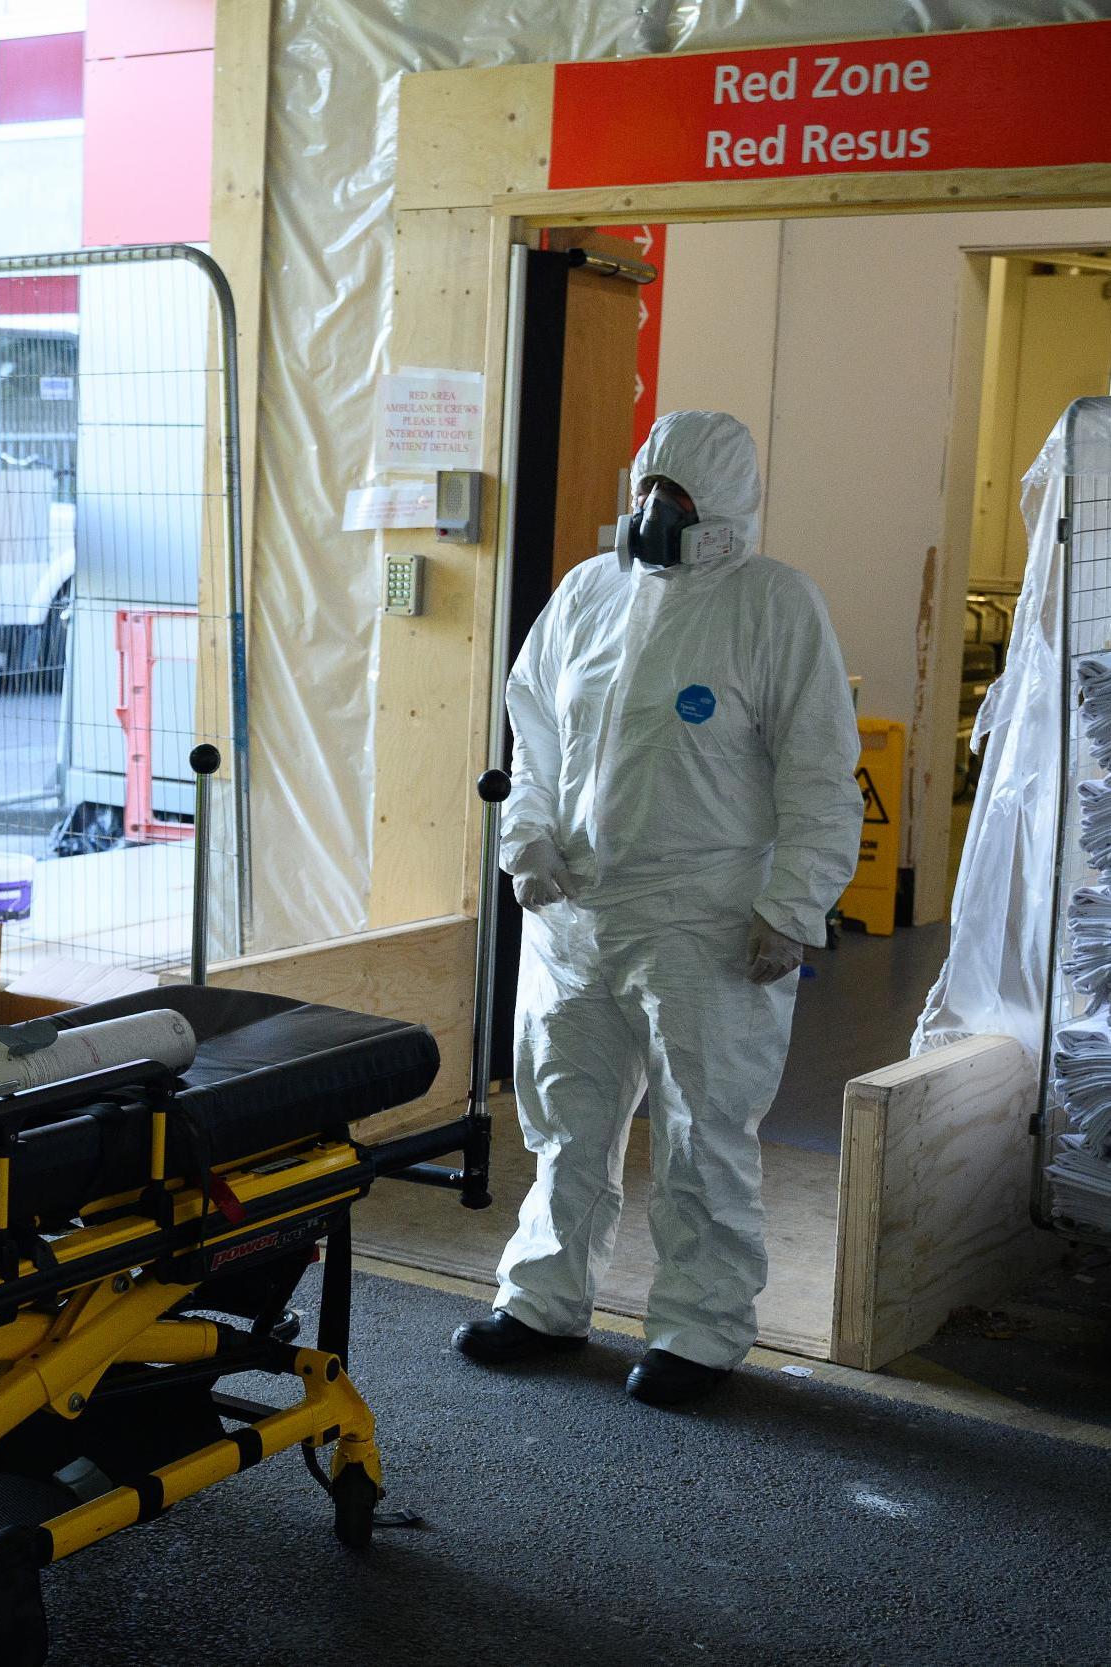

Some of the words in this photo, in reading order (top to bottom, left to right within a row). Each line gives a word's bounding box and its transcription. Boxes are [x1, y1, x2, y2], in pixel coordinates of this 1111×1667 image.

[713, 57, 797, 105] Red
[812, 56, 930, 98] Zone
[705, 124, 787, 168] Red
[801, 125, 930, 163] Resus
[409, 391, 428, 400] RED
[430, 391, 456, 401] AREA
[385, 404, 442, 413] AMBULANCE
[444, 404, 478, 415] CREWS
[403, 416, 439, 426] PLEASE
[440, 417, 457, 426] USE
[385, 429, 434, 438] INTERCOM
[436, 430, 449, 439] TO
[450, 430, 474, 440] GIVE
[389, 441, 428, 451] PATIENT
[430, 442, 469, 452] DETAILS
